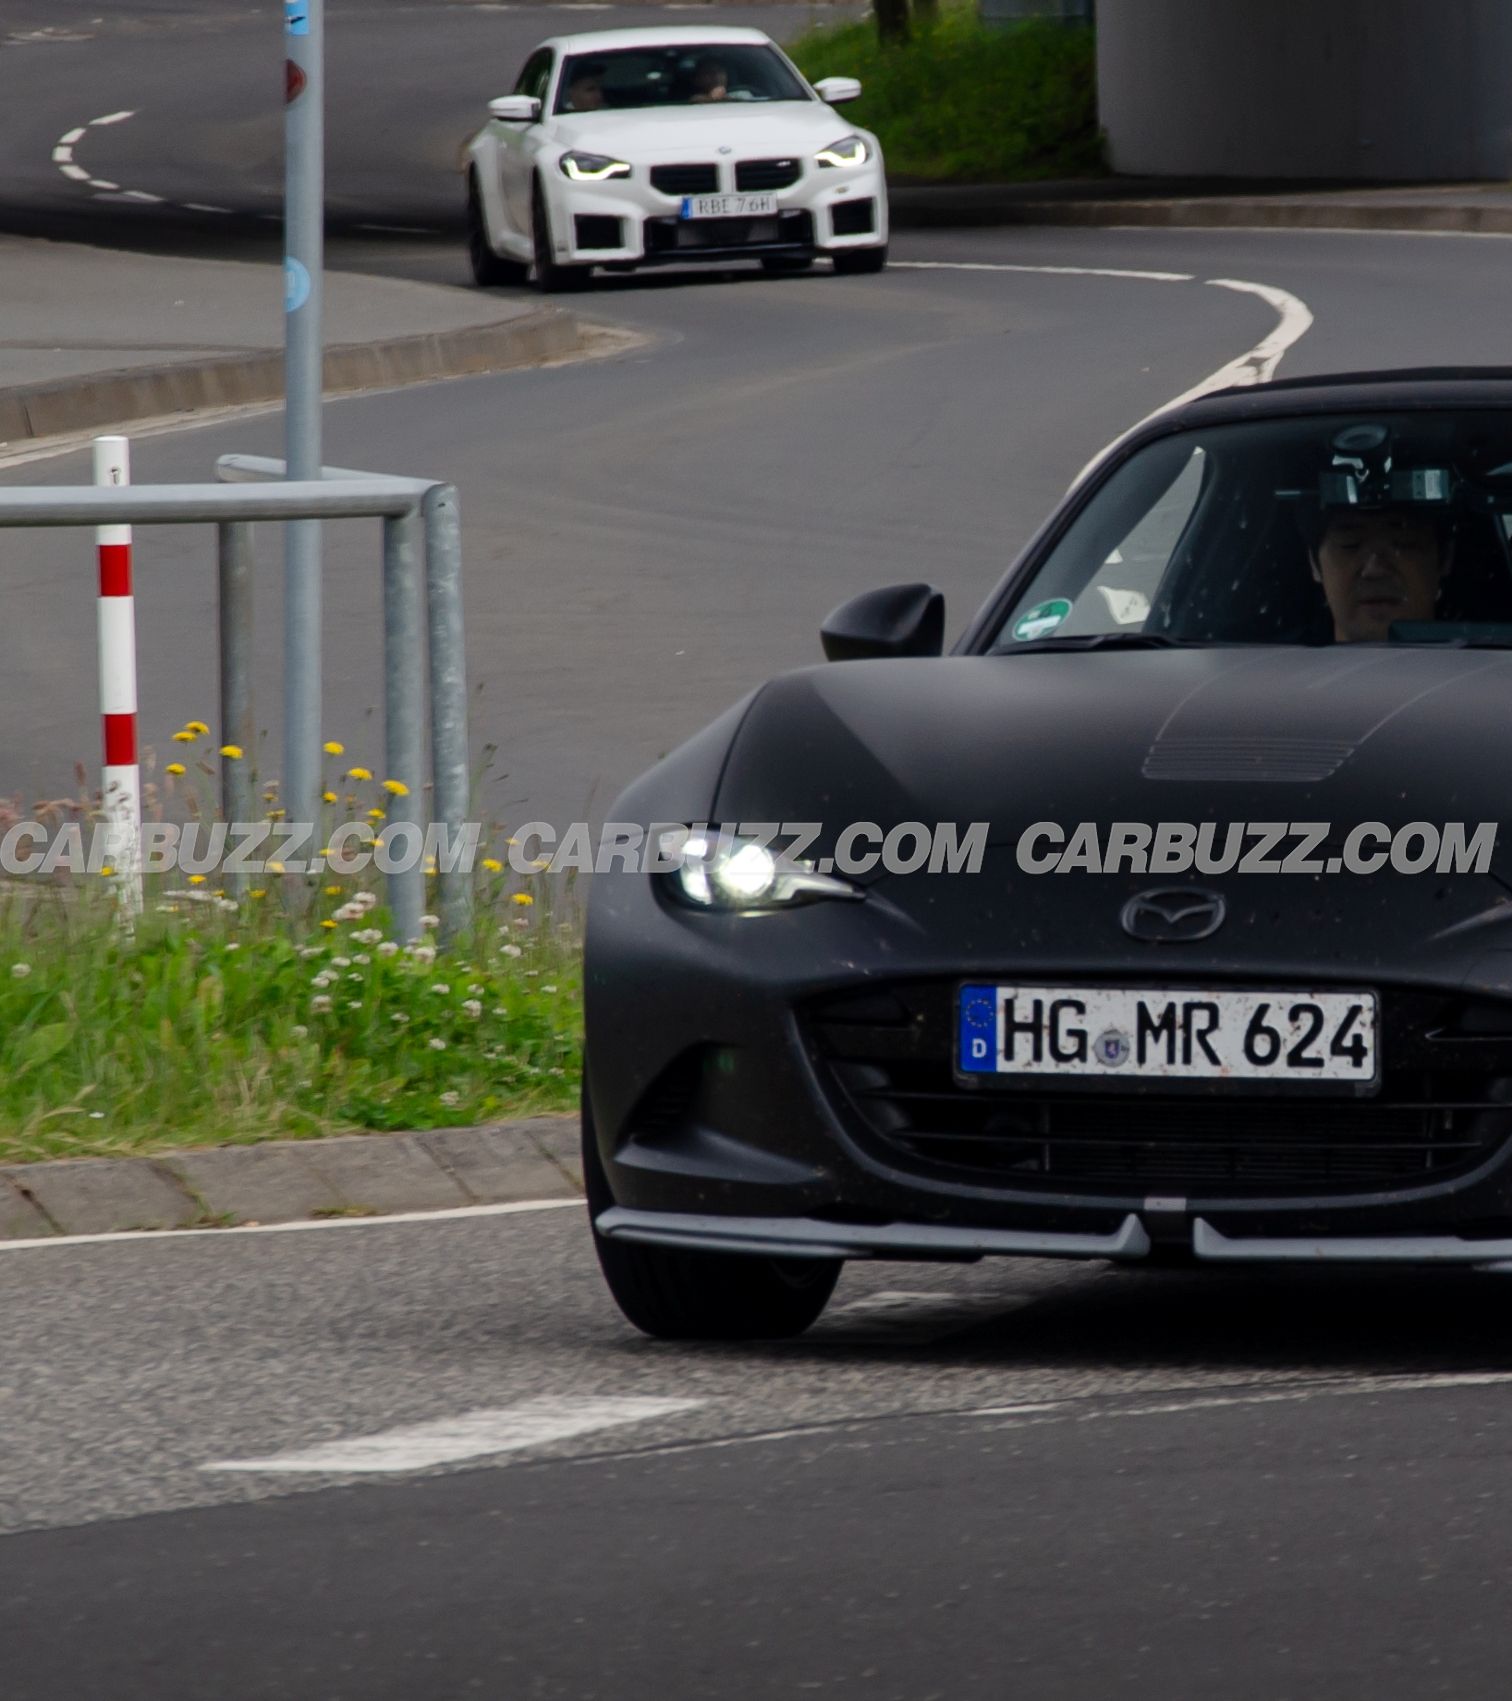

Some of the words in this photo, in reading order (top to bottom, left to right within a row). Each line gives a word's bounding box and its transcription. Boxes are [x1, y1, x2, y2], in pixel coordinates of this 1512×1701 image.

[971, 1038, 987, 1058] D
[1003, 998, 1087, 1064] HG
[1136, 1001, 1222, 1066] MR
[1244, 1003, 1369, 1068] 624
